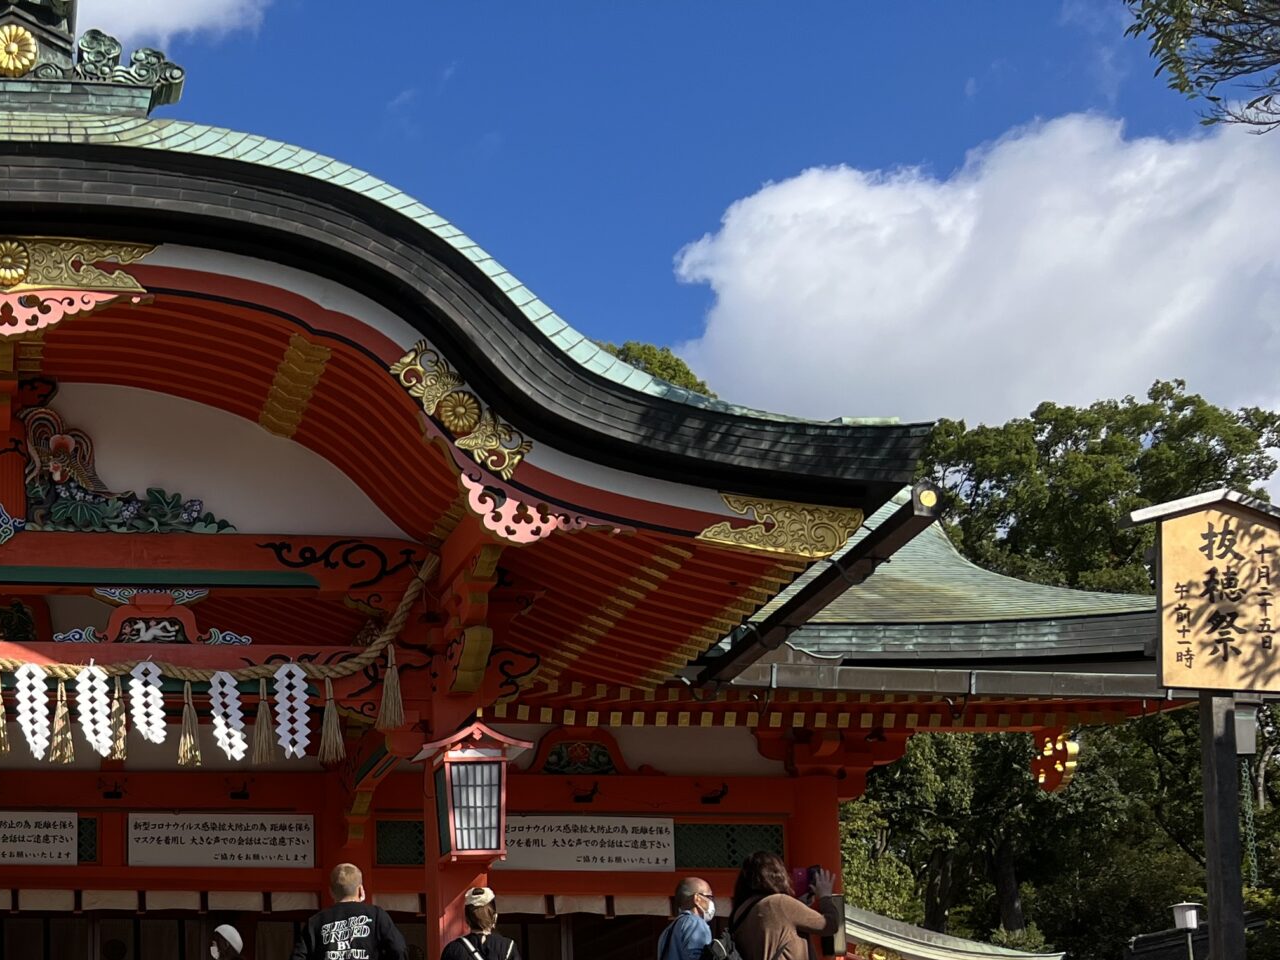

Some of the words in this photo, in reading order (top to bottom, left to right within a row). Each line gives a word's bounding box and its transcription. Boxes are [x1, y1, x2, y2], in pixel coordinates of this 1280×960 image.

[1174, 582, 1195, 669] 午前十一時
[1198, 520, 1246, 662] 抜穂祭
[1255, 543, 1275, 650] 十月二十五日
[337, 940, 352, 950] BY
